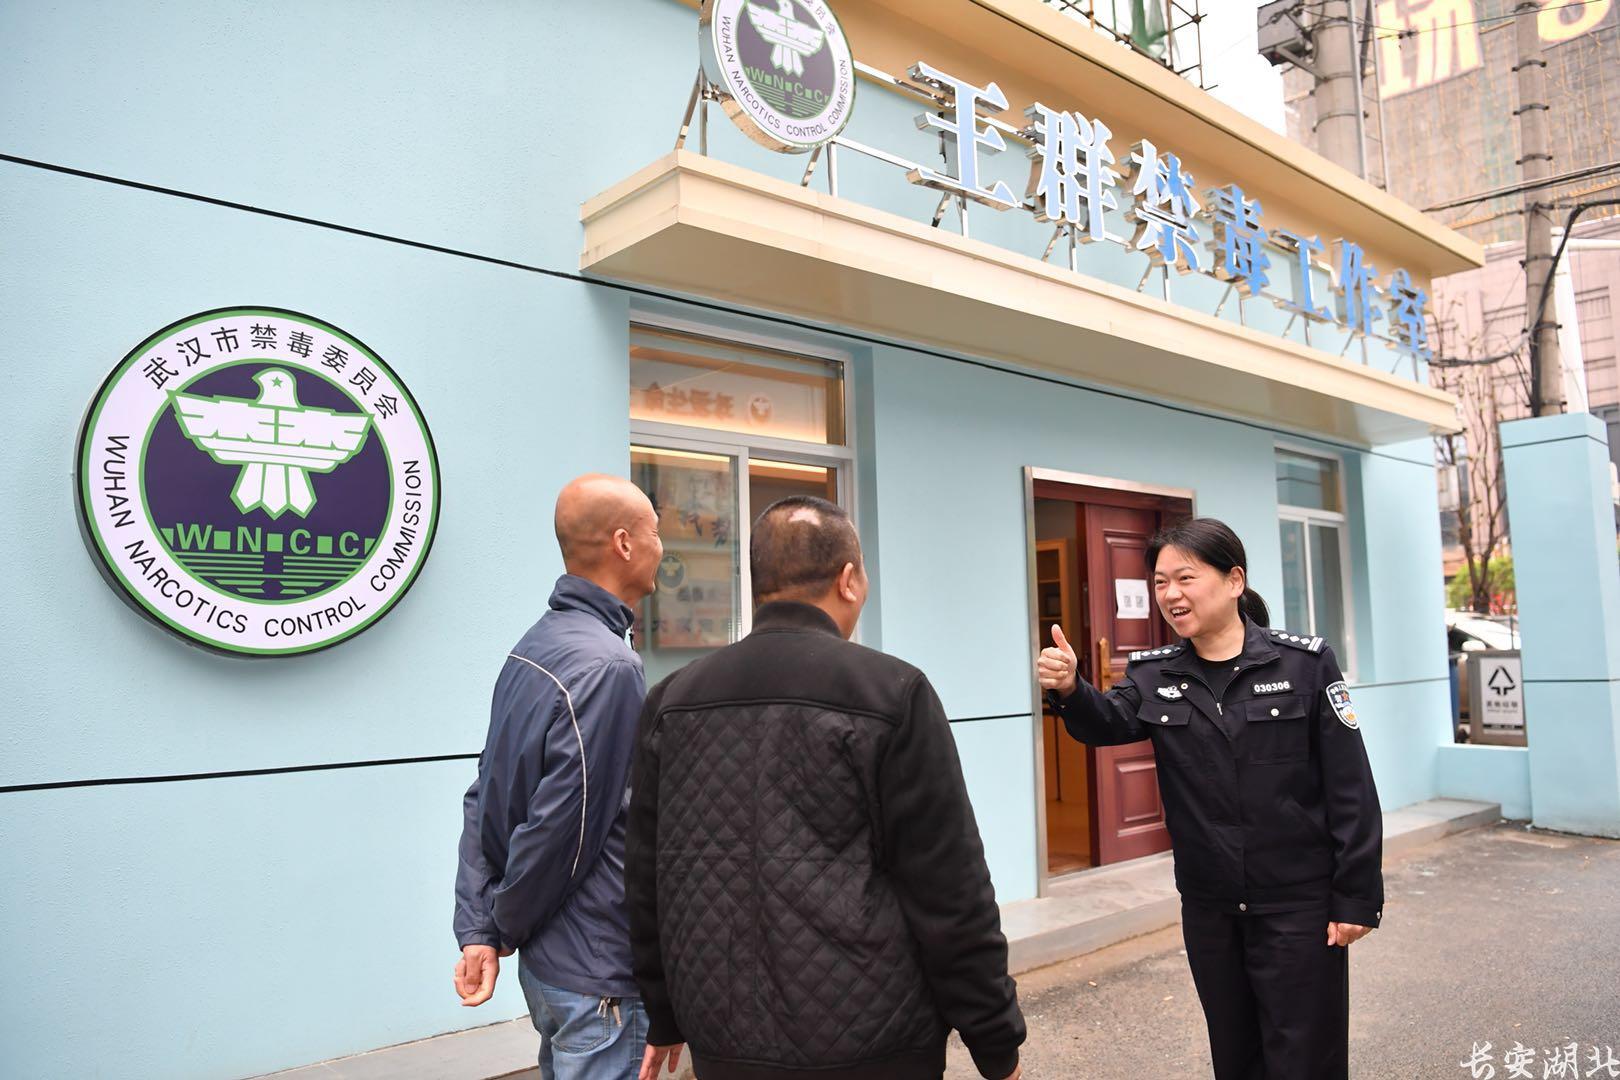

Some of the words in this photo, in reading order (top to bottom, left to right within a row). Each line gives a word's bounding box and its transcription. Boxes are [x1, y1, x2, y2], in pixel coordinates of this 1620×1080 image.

[721, 16, 735, 63] WUHAN
[732, 70, 780, 129] NARCOTICS
[786, 124, 828, 137] CONTROL
[827, 59, 848, 125] COMMISSION
[907, 60, 1432, 361] 王群禁毒工作室
[143, 323, 398, 419] 武汉市禁毒委员会
[103, 435, 135, 529] WUHAN
[124, 539, 248, 634] NARCOTICS
[264, 596, 366, 637] CONTROL
[370, 459, 422, 592] COMMISSION
[1254, 681, 1290, 693] 030306
